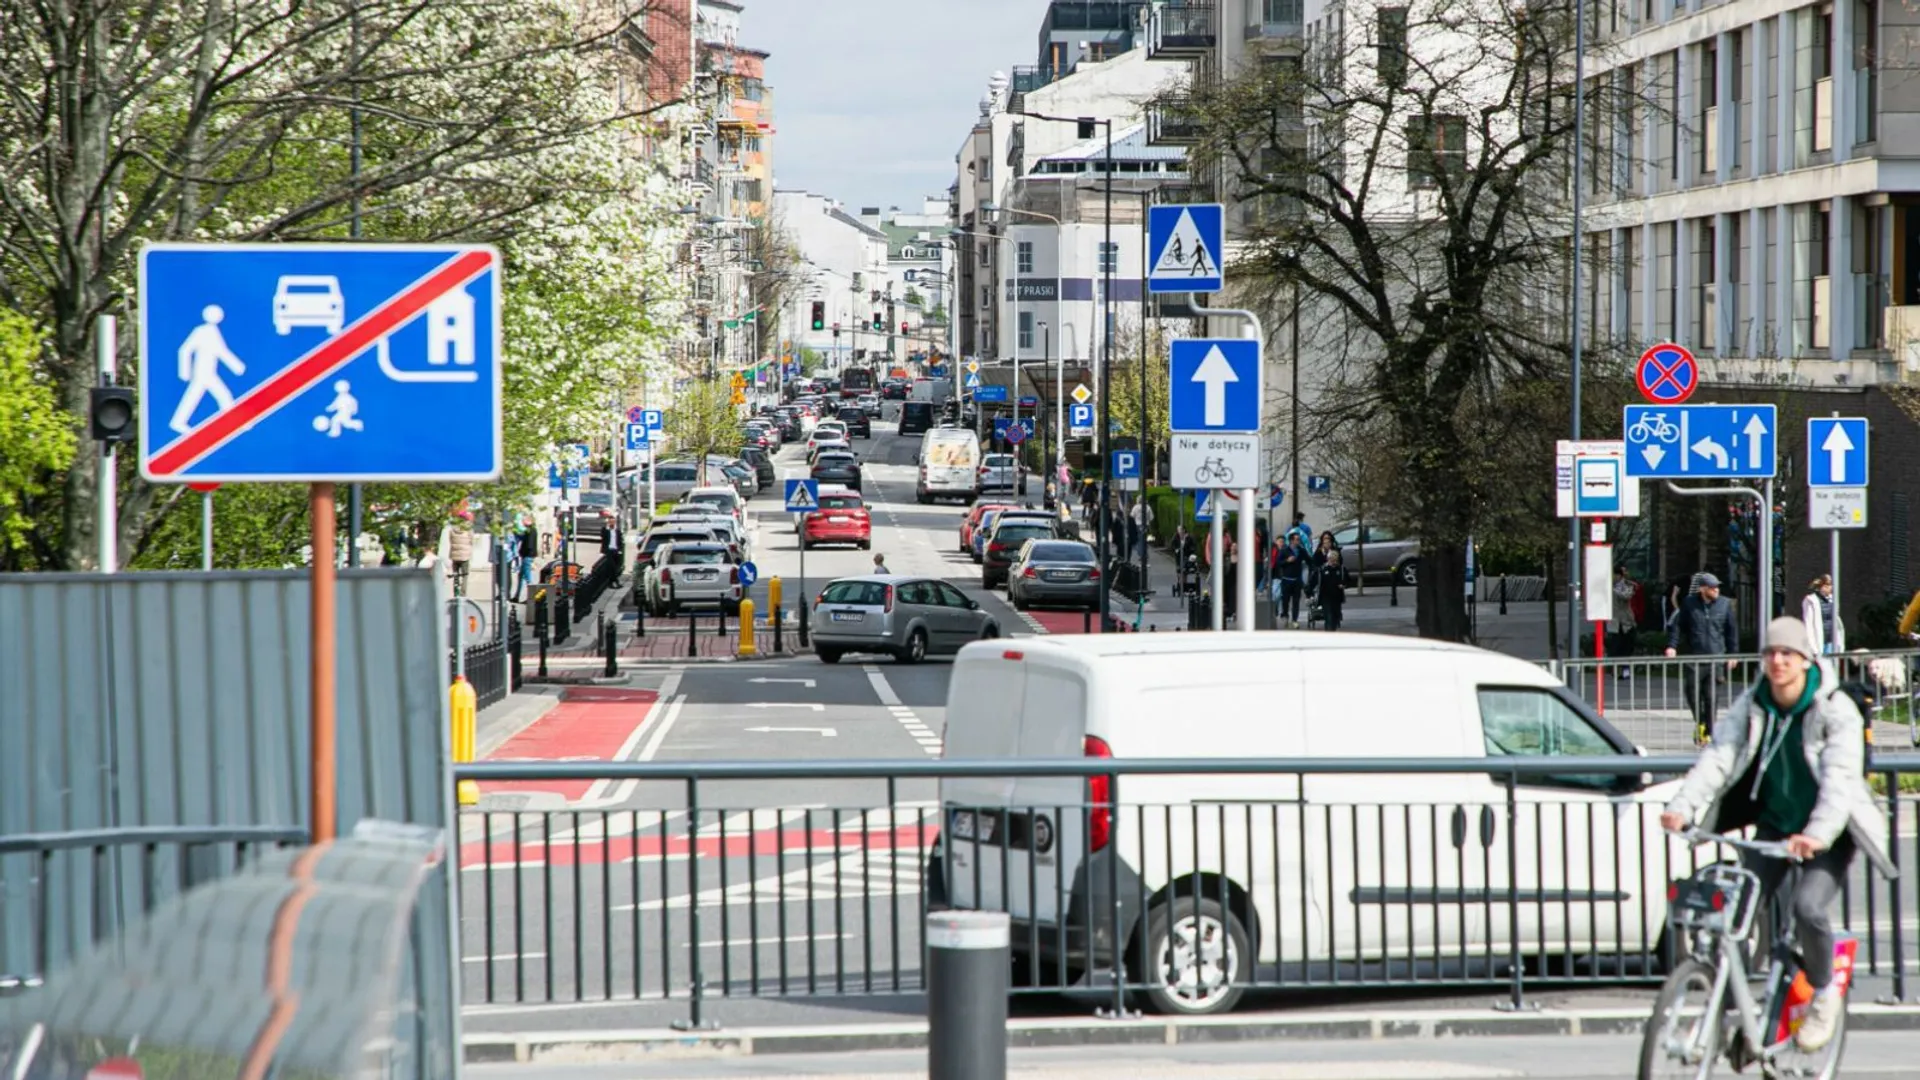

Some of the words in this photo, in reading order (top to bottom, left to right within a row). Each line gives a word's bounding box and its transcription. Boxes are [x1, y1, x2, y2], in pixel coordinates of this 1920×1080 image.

[1024, 285, 1054, 296] PRASKI
[645, 411, 659, 427] P
[1075, 406, 1089, 425] P
[631, 425, 645, 442] P
[1179, 439, 1199, 450] Nie
[1208, 439, 1251, 452] dotyczy
[1119, 453, 1134, 475] P
[1315, 477, 1325, 488] P
